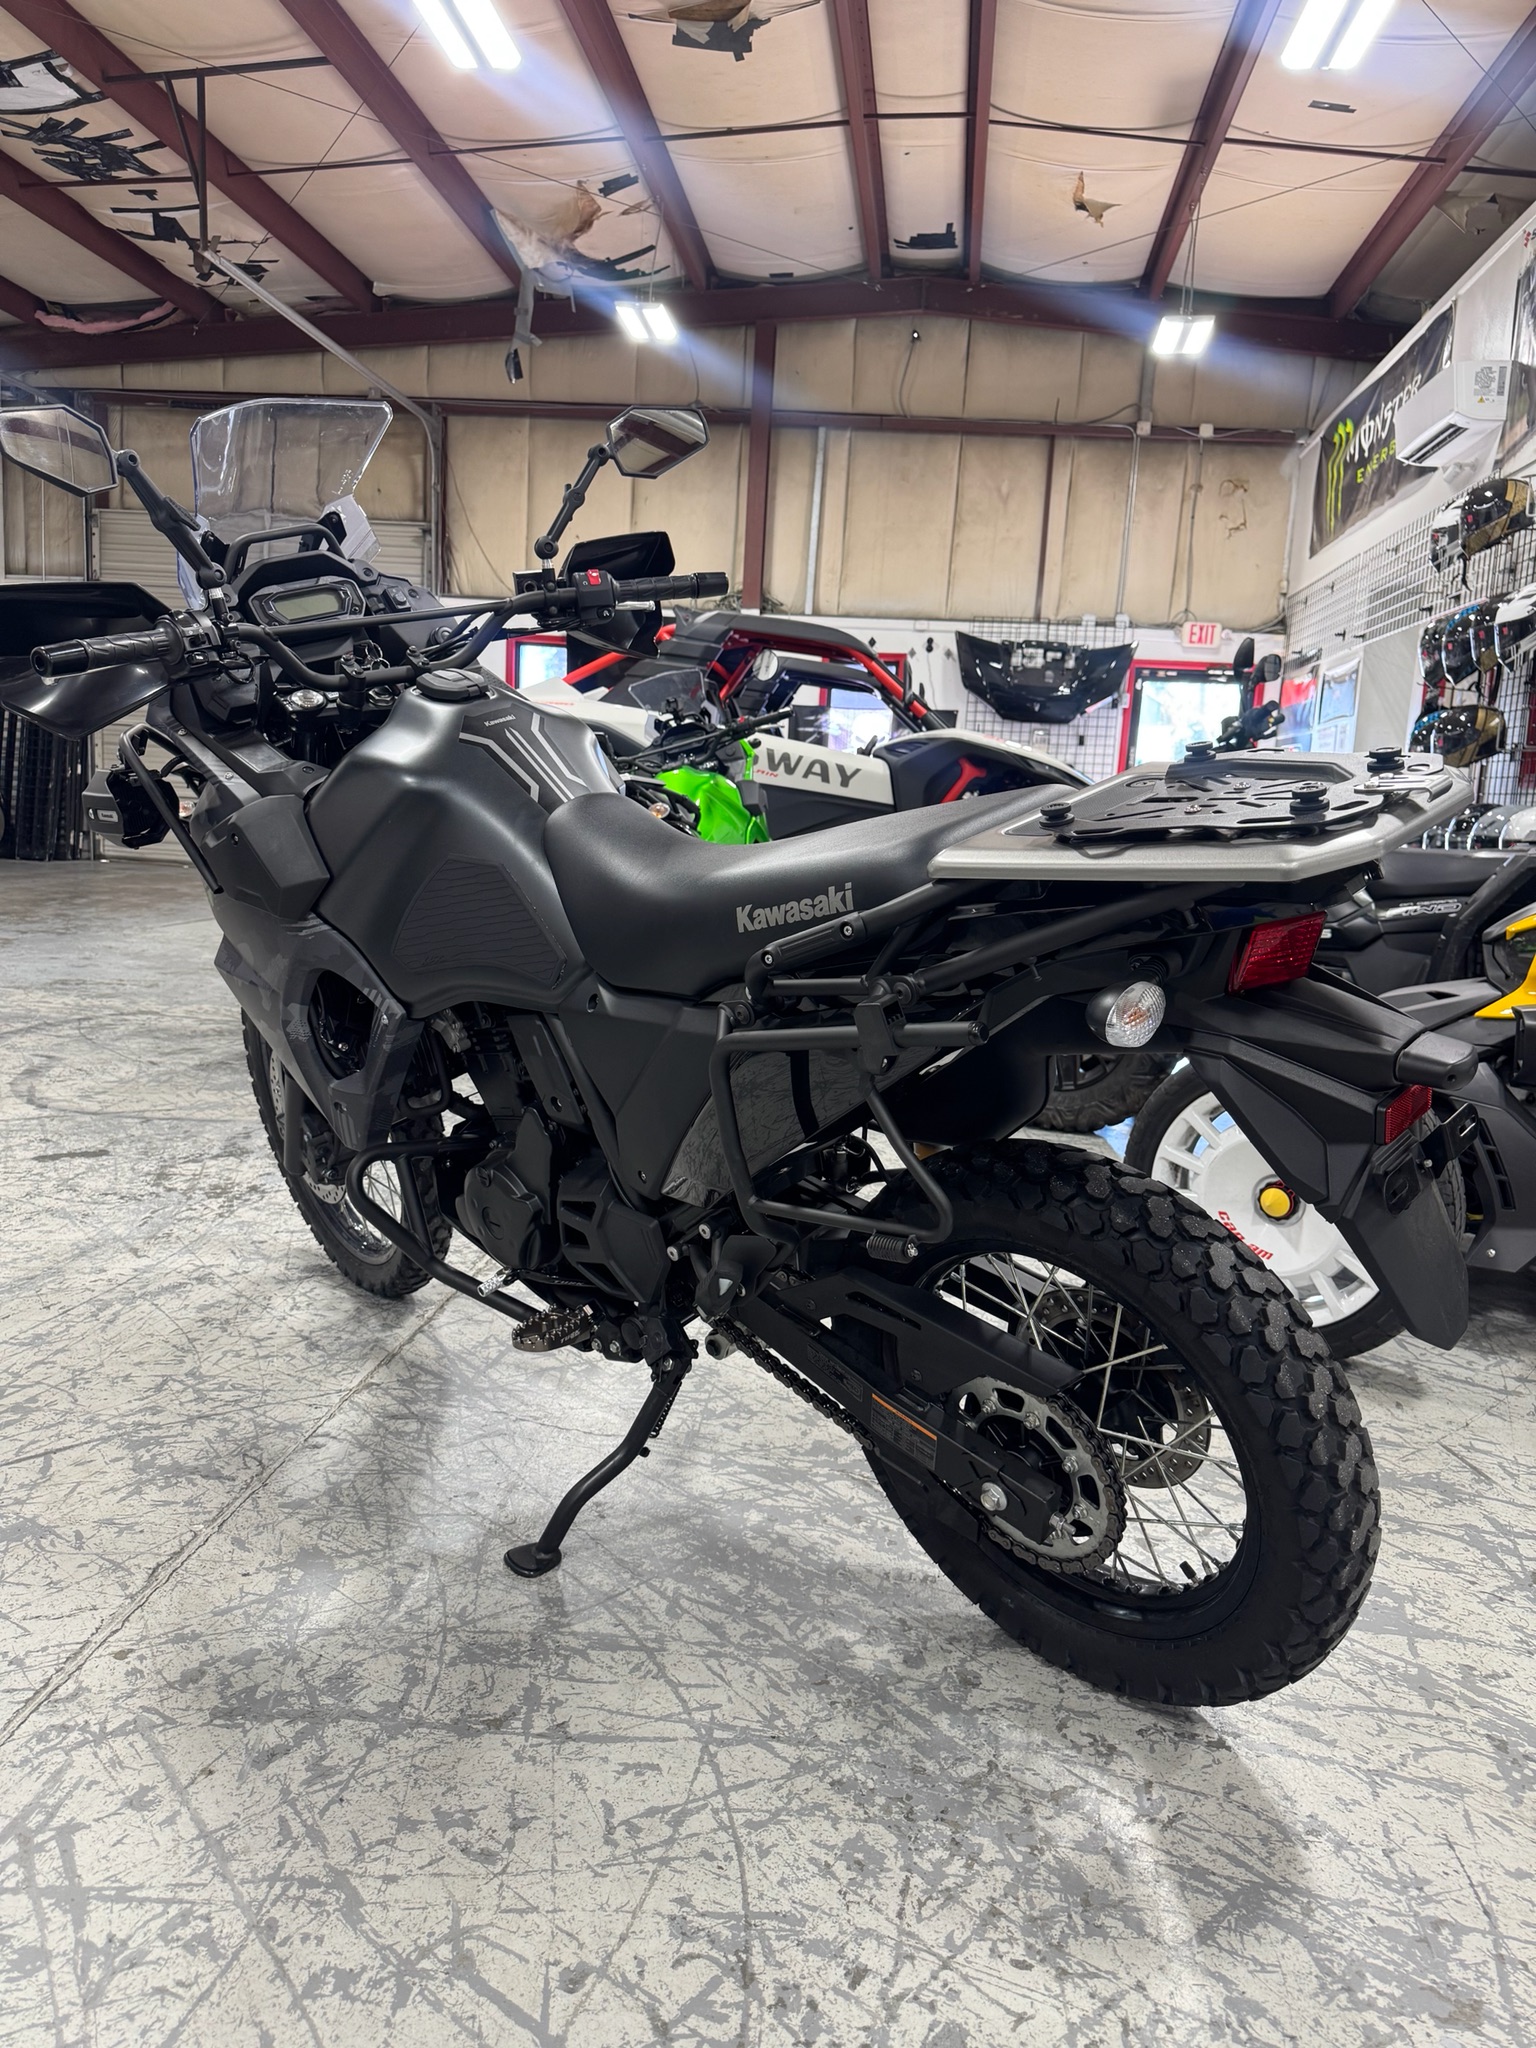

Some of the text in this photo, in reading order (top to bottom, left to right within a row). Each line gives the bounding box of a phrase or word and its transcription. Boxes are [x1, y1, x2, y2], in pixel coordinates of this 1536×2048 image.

[1346, 373, 1422, 463] MONSTER
[1356, 439, 1396, 484] ENERG
[1188, 623, 1217, 645] EXIT
[483, 713, 517, 727] Kawasaki
[753, 747, 862, 788] WAY
[736, 881, 854, 933] Kawasaki
